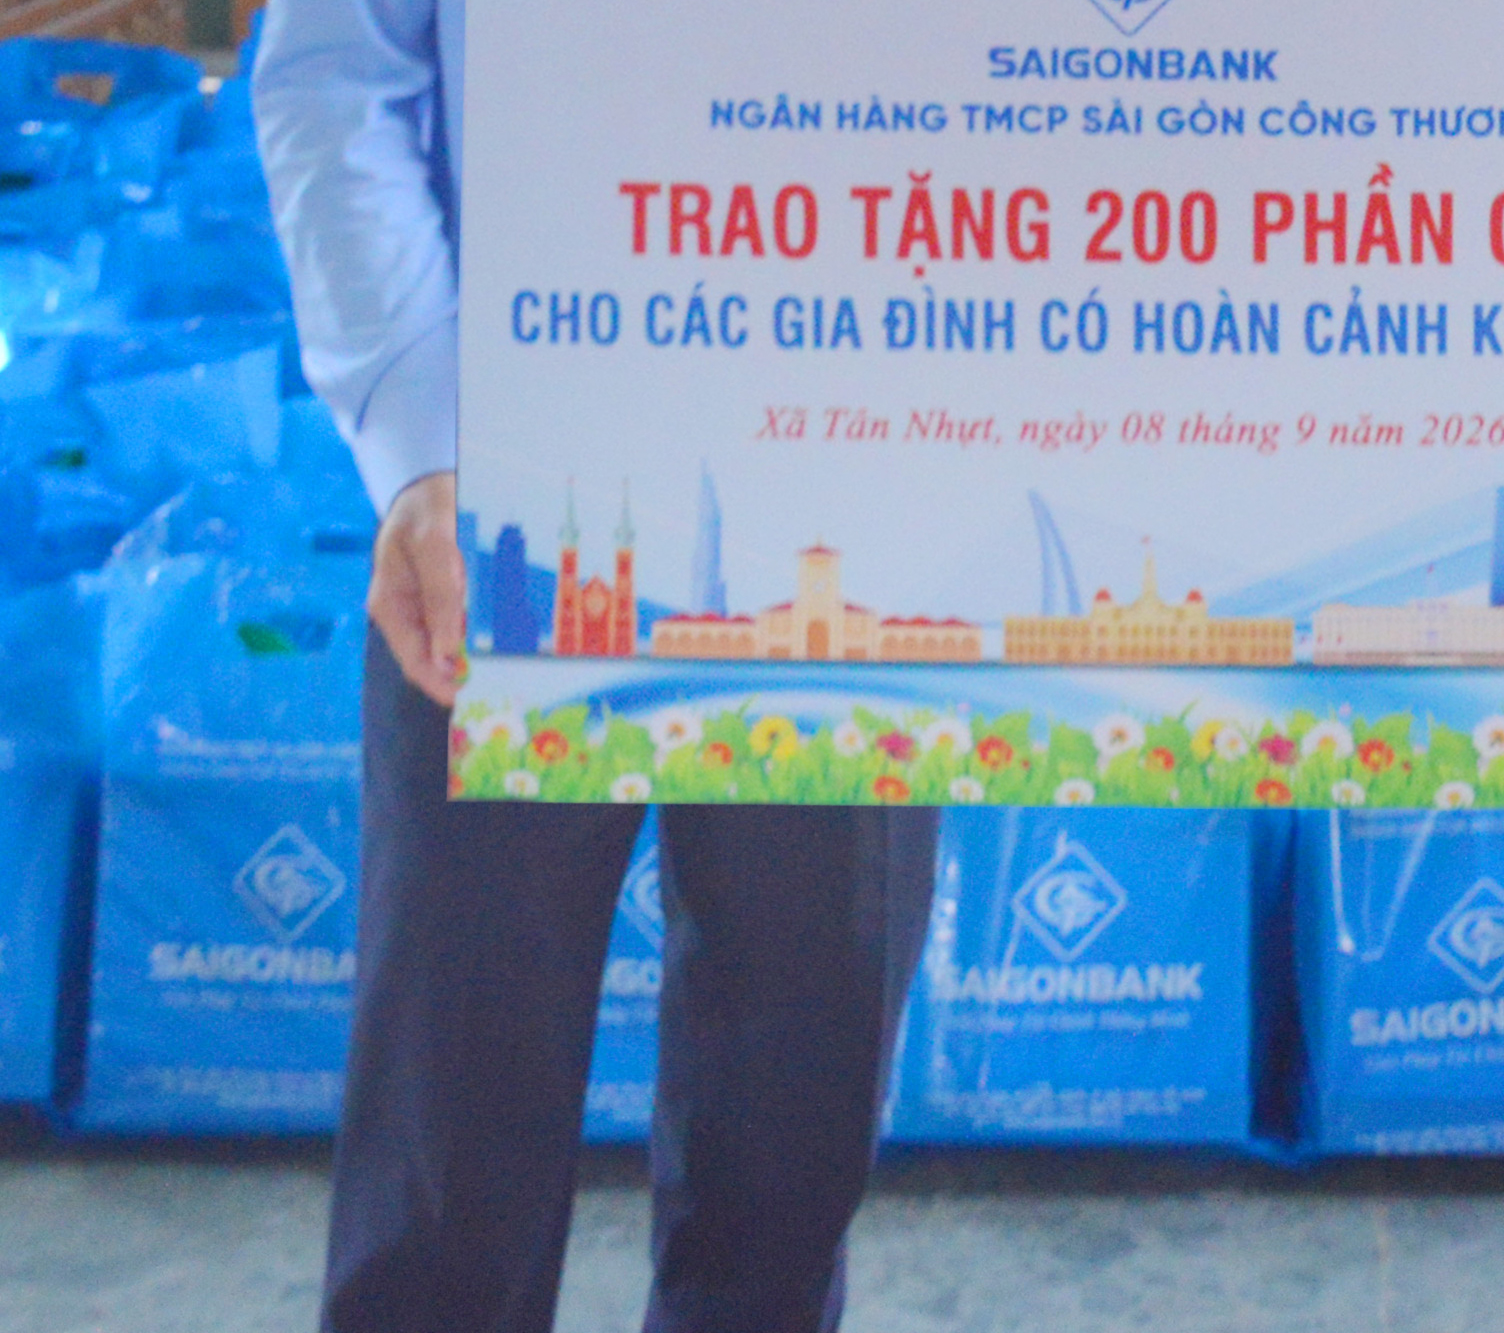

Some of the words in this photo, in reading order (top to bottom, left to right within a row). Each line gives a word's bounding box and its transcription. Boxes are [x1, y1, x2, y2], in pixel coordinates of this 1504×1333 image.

[987, 46, 1277, 82] SAIGONBANK
[709, 92, 823, 130] NGÂN
[836, 96, 948, 133] HÀNG
[961, 103, 1070, 135] TMCP
[1082, 99, 1144, 135] SÀI
[1155, 99, 1246, 137] GÒN
[1257, 98, 1378, 138] CÔNG
[619, 181, 819, 260] TRAO
[850, 172, 1050, 278] TẶNG
[1085, 189, 1218, 265] 200
[1252, 163, 1454, 265] PHẦN
[510, 289, 622, 347] CHO
[644, 282, 748, 349] CÁC
[772, 295, 862, 350] GIA
[882, 283, 1016, 352] ĐÌNH
[1039, 288, 1110, 354] CÓ
[1133, 289, 1280, 355] HOÀN
[1303, 286, 1448, 357] CẢNH
[757, 405, 807, 441] Xã
[824, 407, 890, 441] Tân
[904, 408, 1002, 447] Nhựt,
[1018, 412, 1108, 451] ngày
[1120, 412, 1166, 442] 08
[1177, 411, 1282, 453] tháng
[1296, 414, 1318, 444] 9
[1328, 415, 1405, 446] năm
[151, 941, 358, 986] SAIGONBA
